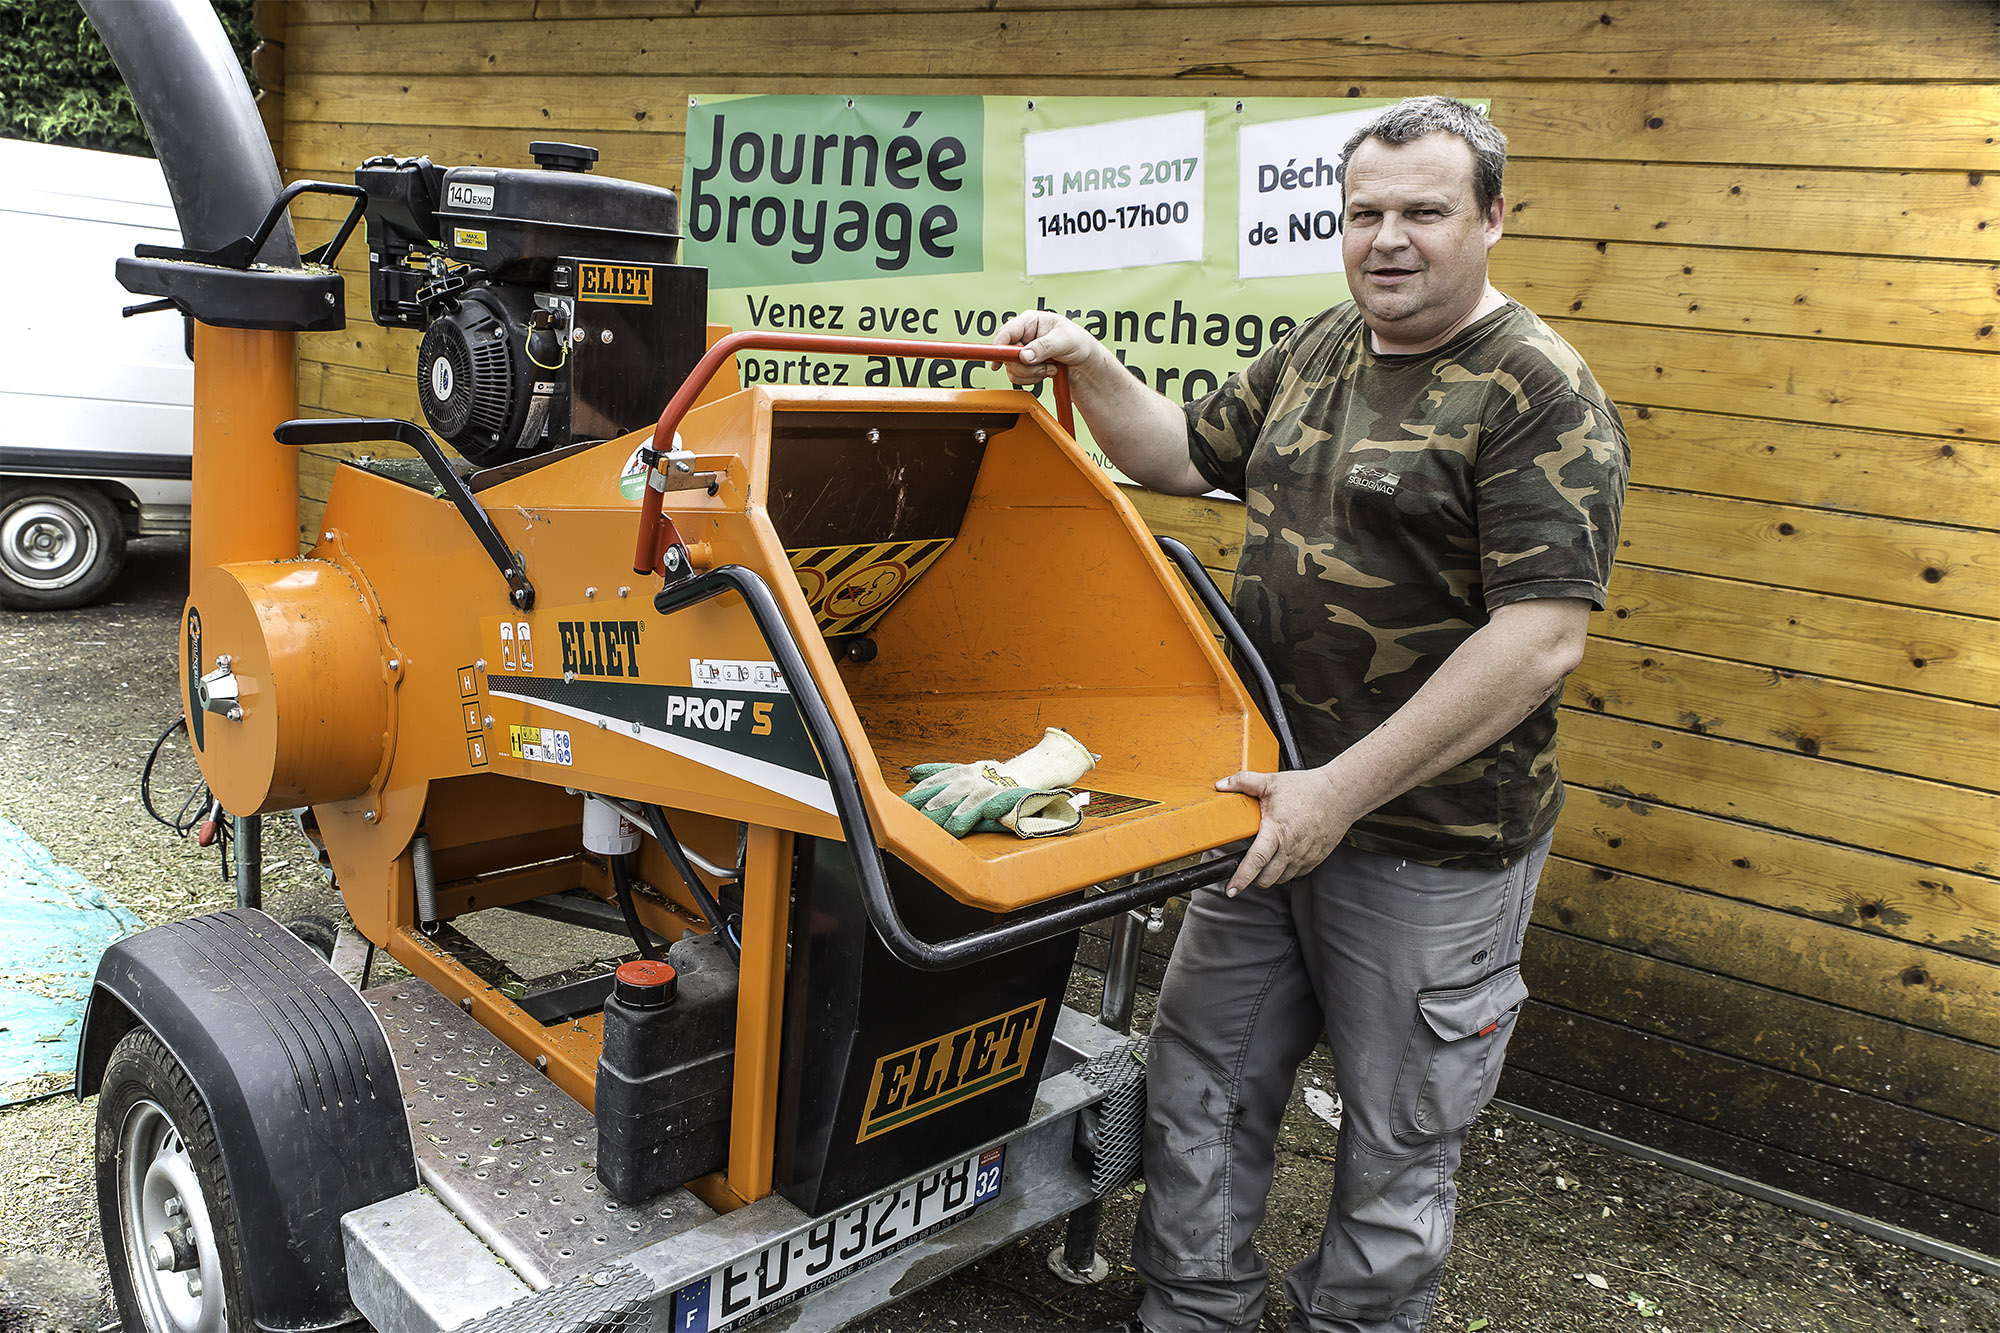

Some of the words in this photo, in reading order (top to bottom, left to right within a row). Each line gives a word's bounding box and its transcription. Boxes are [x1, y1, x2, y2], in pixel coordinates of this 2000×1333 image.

[693, 111, 966, 192] Journée
[450, 186, 473, 204] 14.0
[1032, 175, 1054, 198] 31
[1062, 165, 1132, 194] MARS
[1139, 157, 1198, 186] 2017
[689, 167, 958, 271] broyage
[1038, 201, 1189, 238] 14h00-17h00
[1248, 221, 1278, 246] de
[1289, 210, 1344, 242] NO
[582, 266, 650, 295] ELIET
[747, 294, 844, 330] Venez
[858, 306, 938, 334] avec
[736, 355, 849, 388] partez
[864, 356, 986, 389] avec
[558, 620, 641, 677] ELIET
[464, 675, 472, 691] H
[469, 710, 476, 725] E
[666, 695, 745, 732] PROF
[751, 701, 775, 736] 5
[474, 743, 482, 759] B
[869, 1005, 1040, 1122] ELIET
[976, 1166, 1000, 1198] 32
[738, 1310, 760, 1326] GGE
[765, 1292, 797, 1313] VENET
[804, 1265, 854, 1295] LECTOURE
[857, 1252, 882, 1270] 32700
[686, 1308, 698, 1329] F
